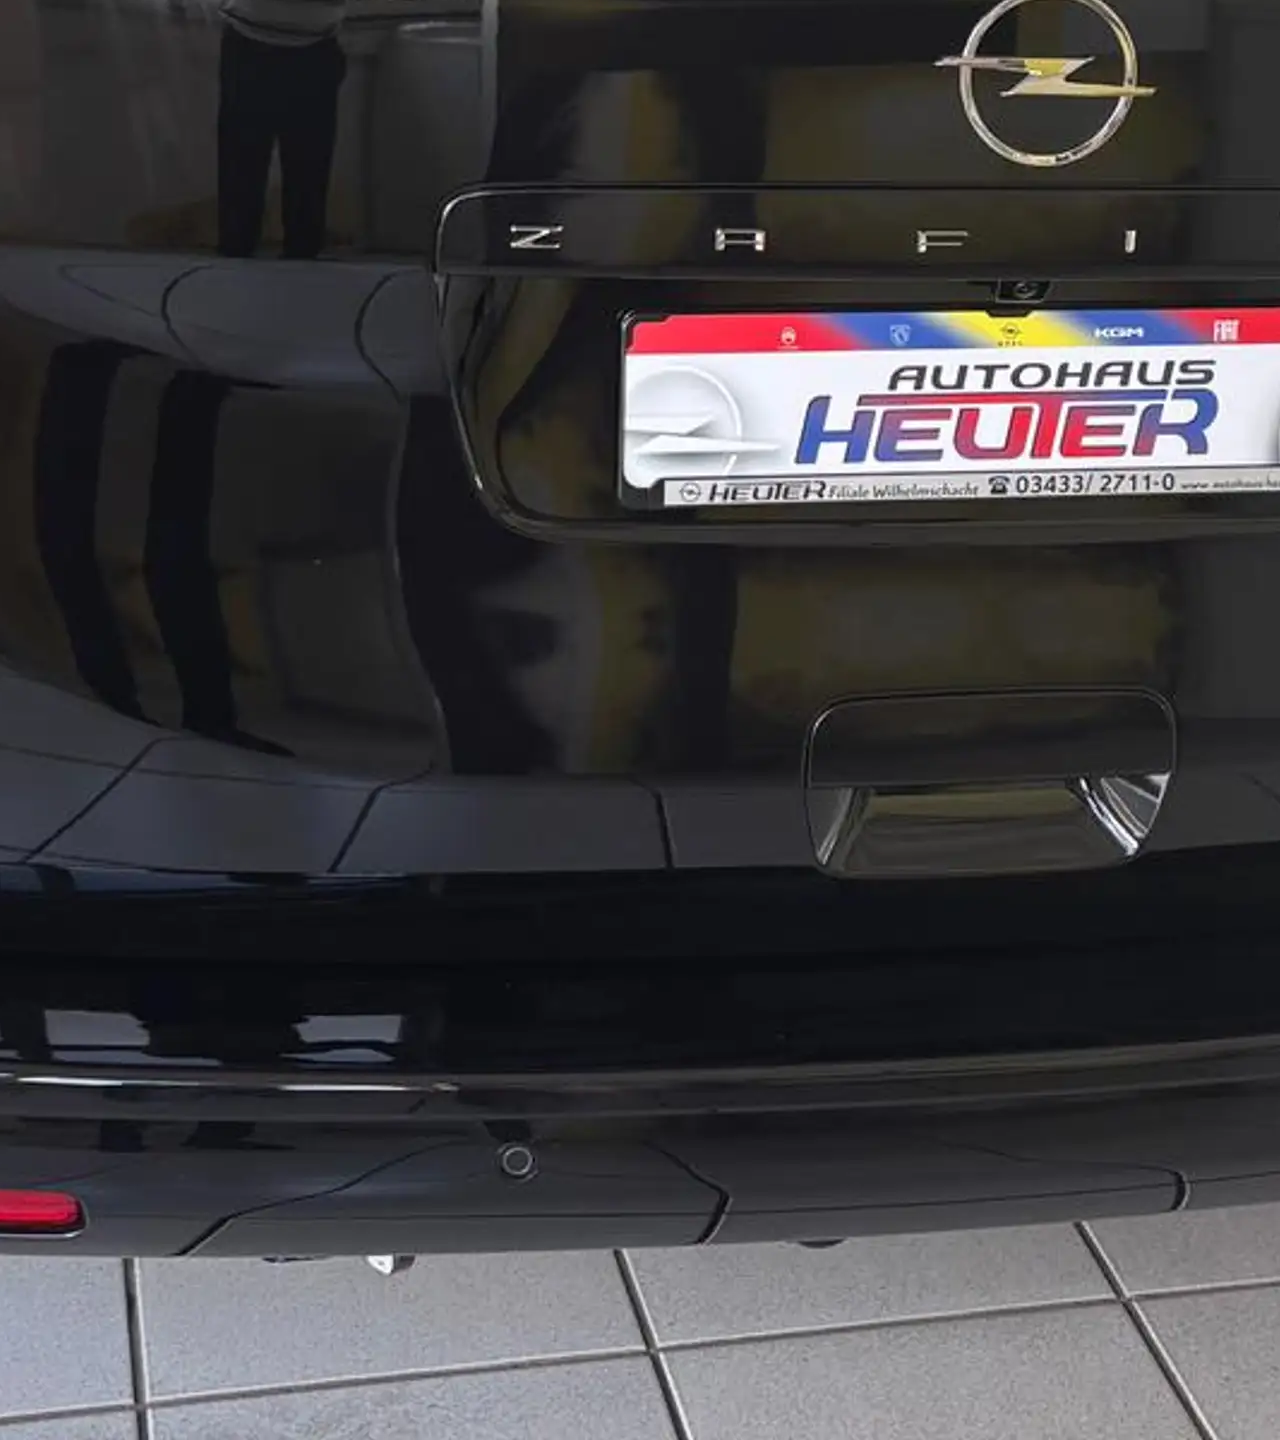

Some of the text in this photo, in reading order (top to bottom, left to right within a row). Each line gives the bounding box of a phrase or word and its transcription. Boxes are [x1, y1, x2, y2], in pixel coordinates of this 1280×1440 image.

[887, 358, 1219, 392] AUTOHAUS
[793, 387, 1220, 465] HEUTER
[708, 479, 827, 501] HEUTER
[1015, 472, 1094, 495] 03433/
[1098, 471, 1176, 493] 2711-0
